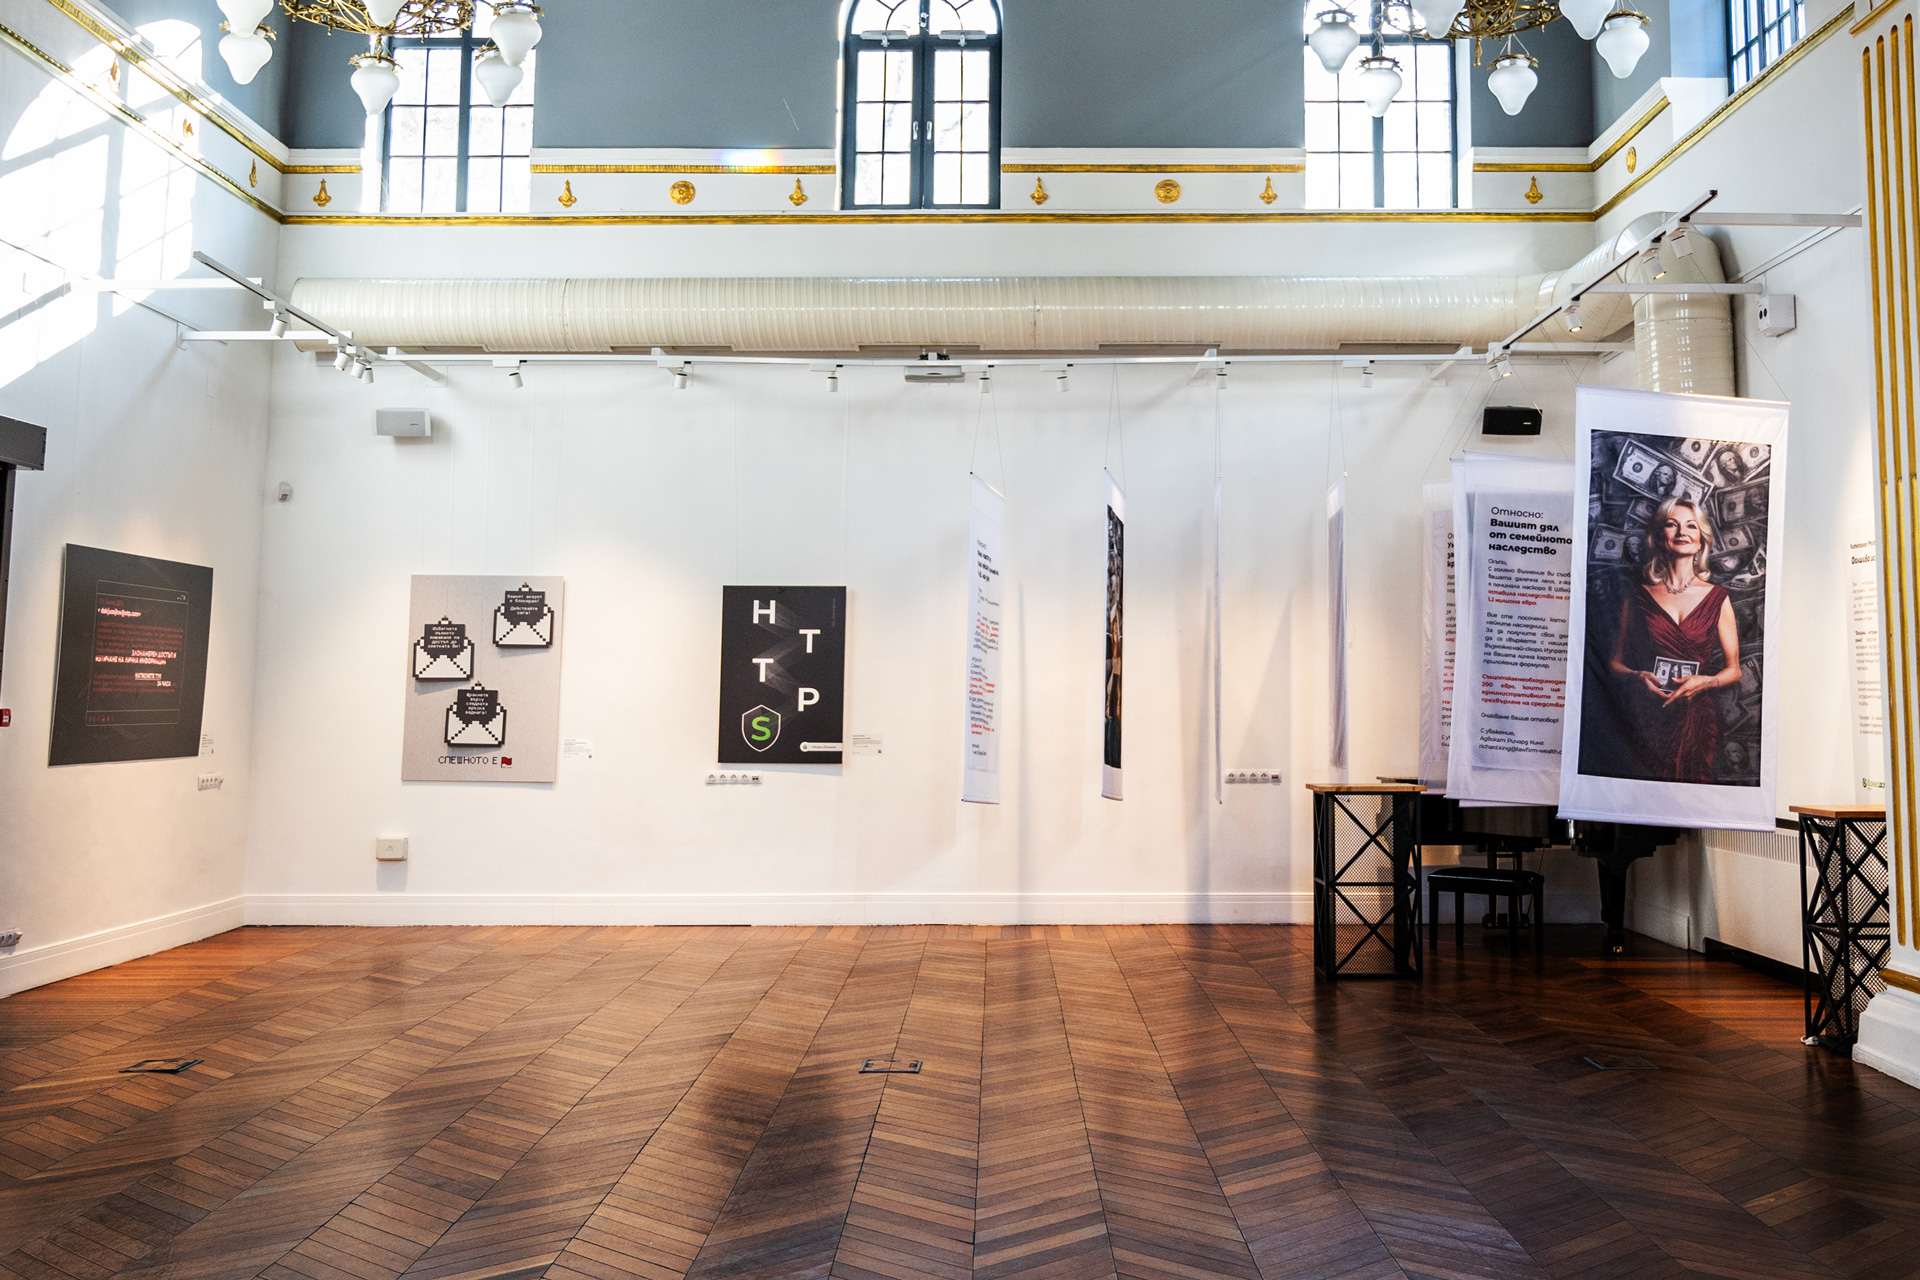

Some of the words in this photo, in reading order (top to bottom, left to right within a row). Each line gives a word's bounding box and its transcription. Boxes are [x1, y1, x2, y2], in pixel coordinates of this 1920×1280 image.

[1491, 506, 1543, 519] Относно:
[1490, 518, 1536, 530] Вашият
[1540, 524, 1559, 532] дял
[1509, 534, 1572, 544] семейното
[1489, 544, 1556, 555] наследство
[753, 600, 776, 624] H
[799, 629, 820, 653] T
[752, 658, 774, 682] T
[798, 688, 820, 712] P
[751, 716, 771, 741] S
[438, 756, 488, 764] СПЕШНОТО
